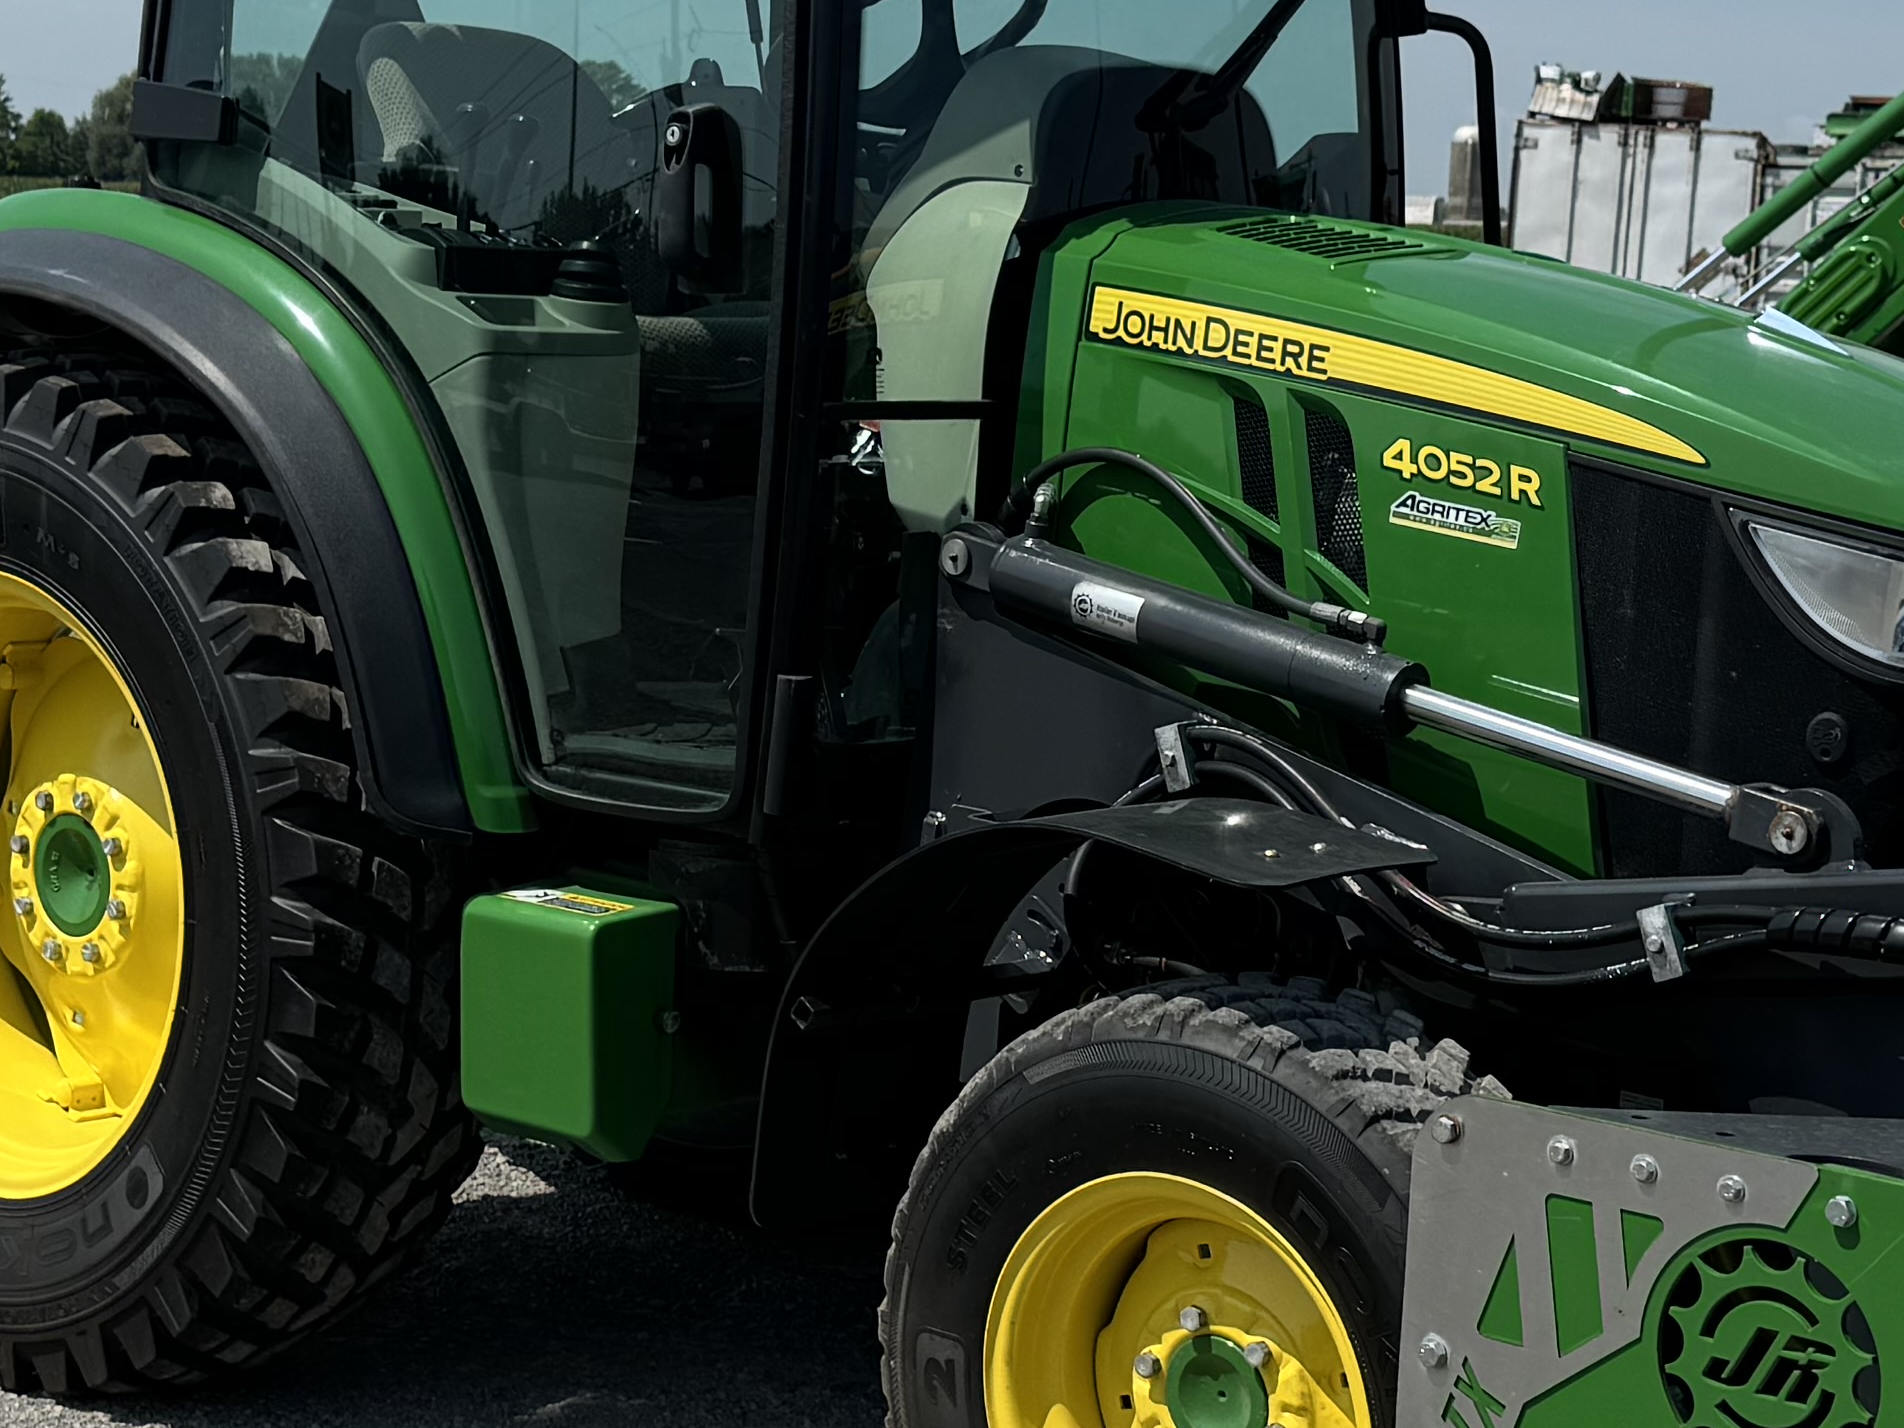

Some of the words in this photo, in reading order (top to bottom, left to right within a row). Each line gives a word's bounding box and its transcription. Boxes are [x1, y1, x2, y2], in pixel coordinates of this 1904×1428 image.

[1102, 301, 1198, 354] JOHN
[1203, 316, 1331, 378] DEERE
[1381, 437, 1503, 497] 4052
[1509, 465, 1543, 507] R
[1395, 493, 1491, 528] AGRITEX
[945, 1169, 1018, 1274] STEEL
[924, 1357, 958, 1404] 2
[1702, 1328, 1836, 1406] JR
